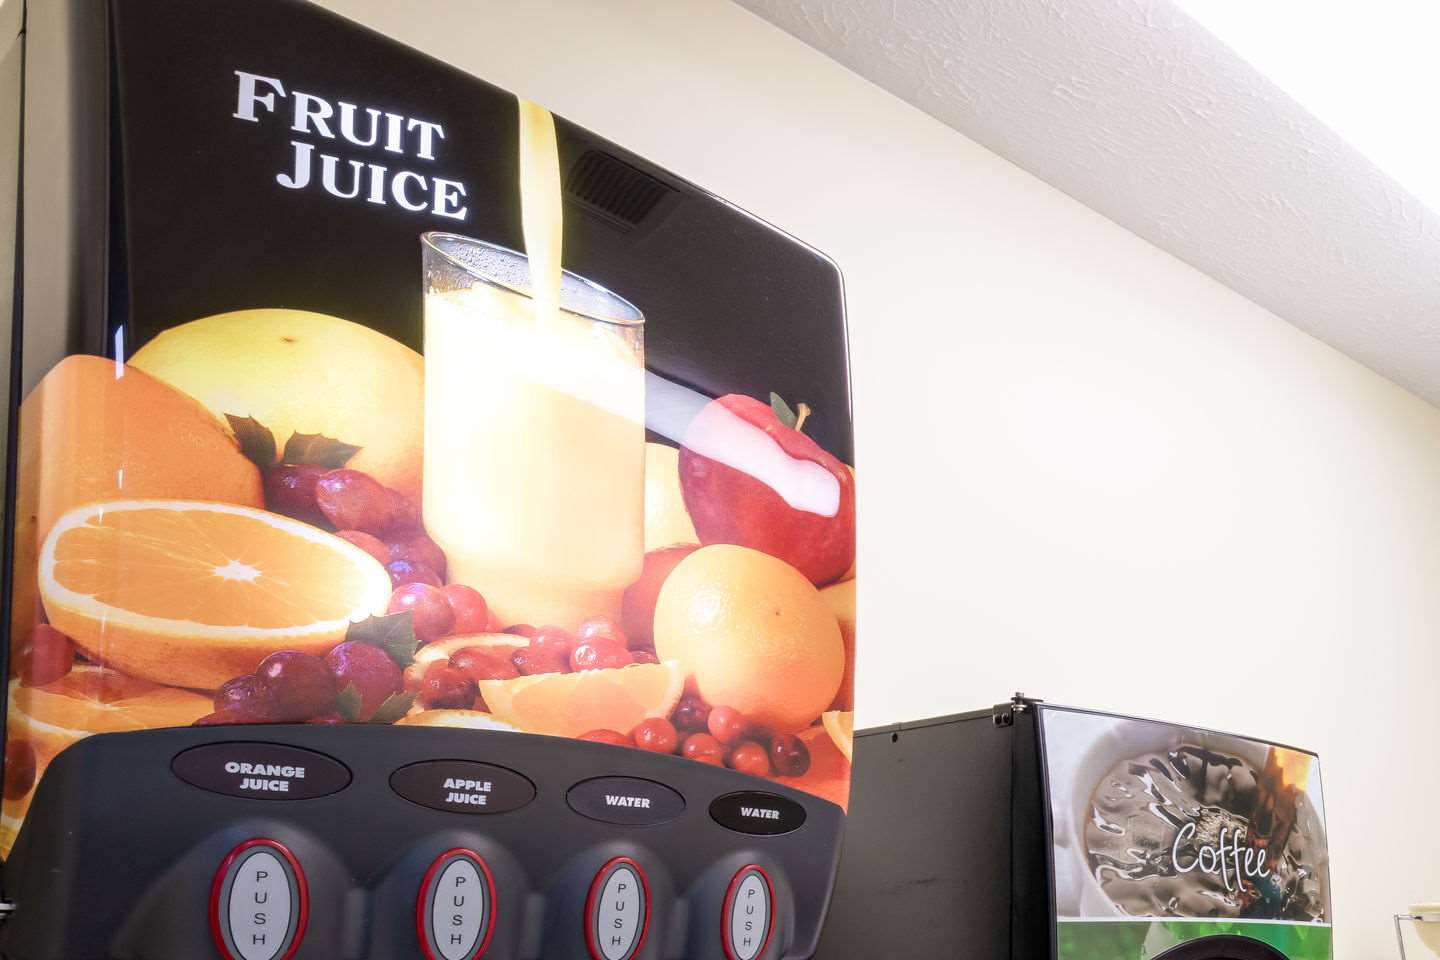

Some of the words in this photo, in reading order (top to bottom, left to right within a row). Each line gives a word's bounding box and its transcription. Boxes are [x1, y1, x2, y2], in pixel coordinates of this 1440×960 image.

[233, 70, 445, 161] FRUIT
[276, 140, 468, 220] JUICE
[225, 761, 305, 779] ORANGE
[240, 778, 289, 792] JUICE
[443, 778, 492, 792] APPLE
[445, 792, 487, 805] JUICE
[605, 795, 650, 809] WATER
[740, 807, 781, 820] WATER
[1172, 823, 1271, 892] Coffee
[252, 870, 269, 946] PUSH
[450, 876, 467, 945] PUSH
[611, 883, 627, 946] PUSH
[743, 888, 756, 947] PUSH
